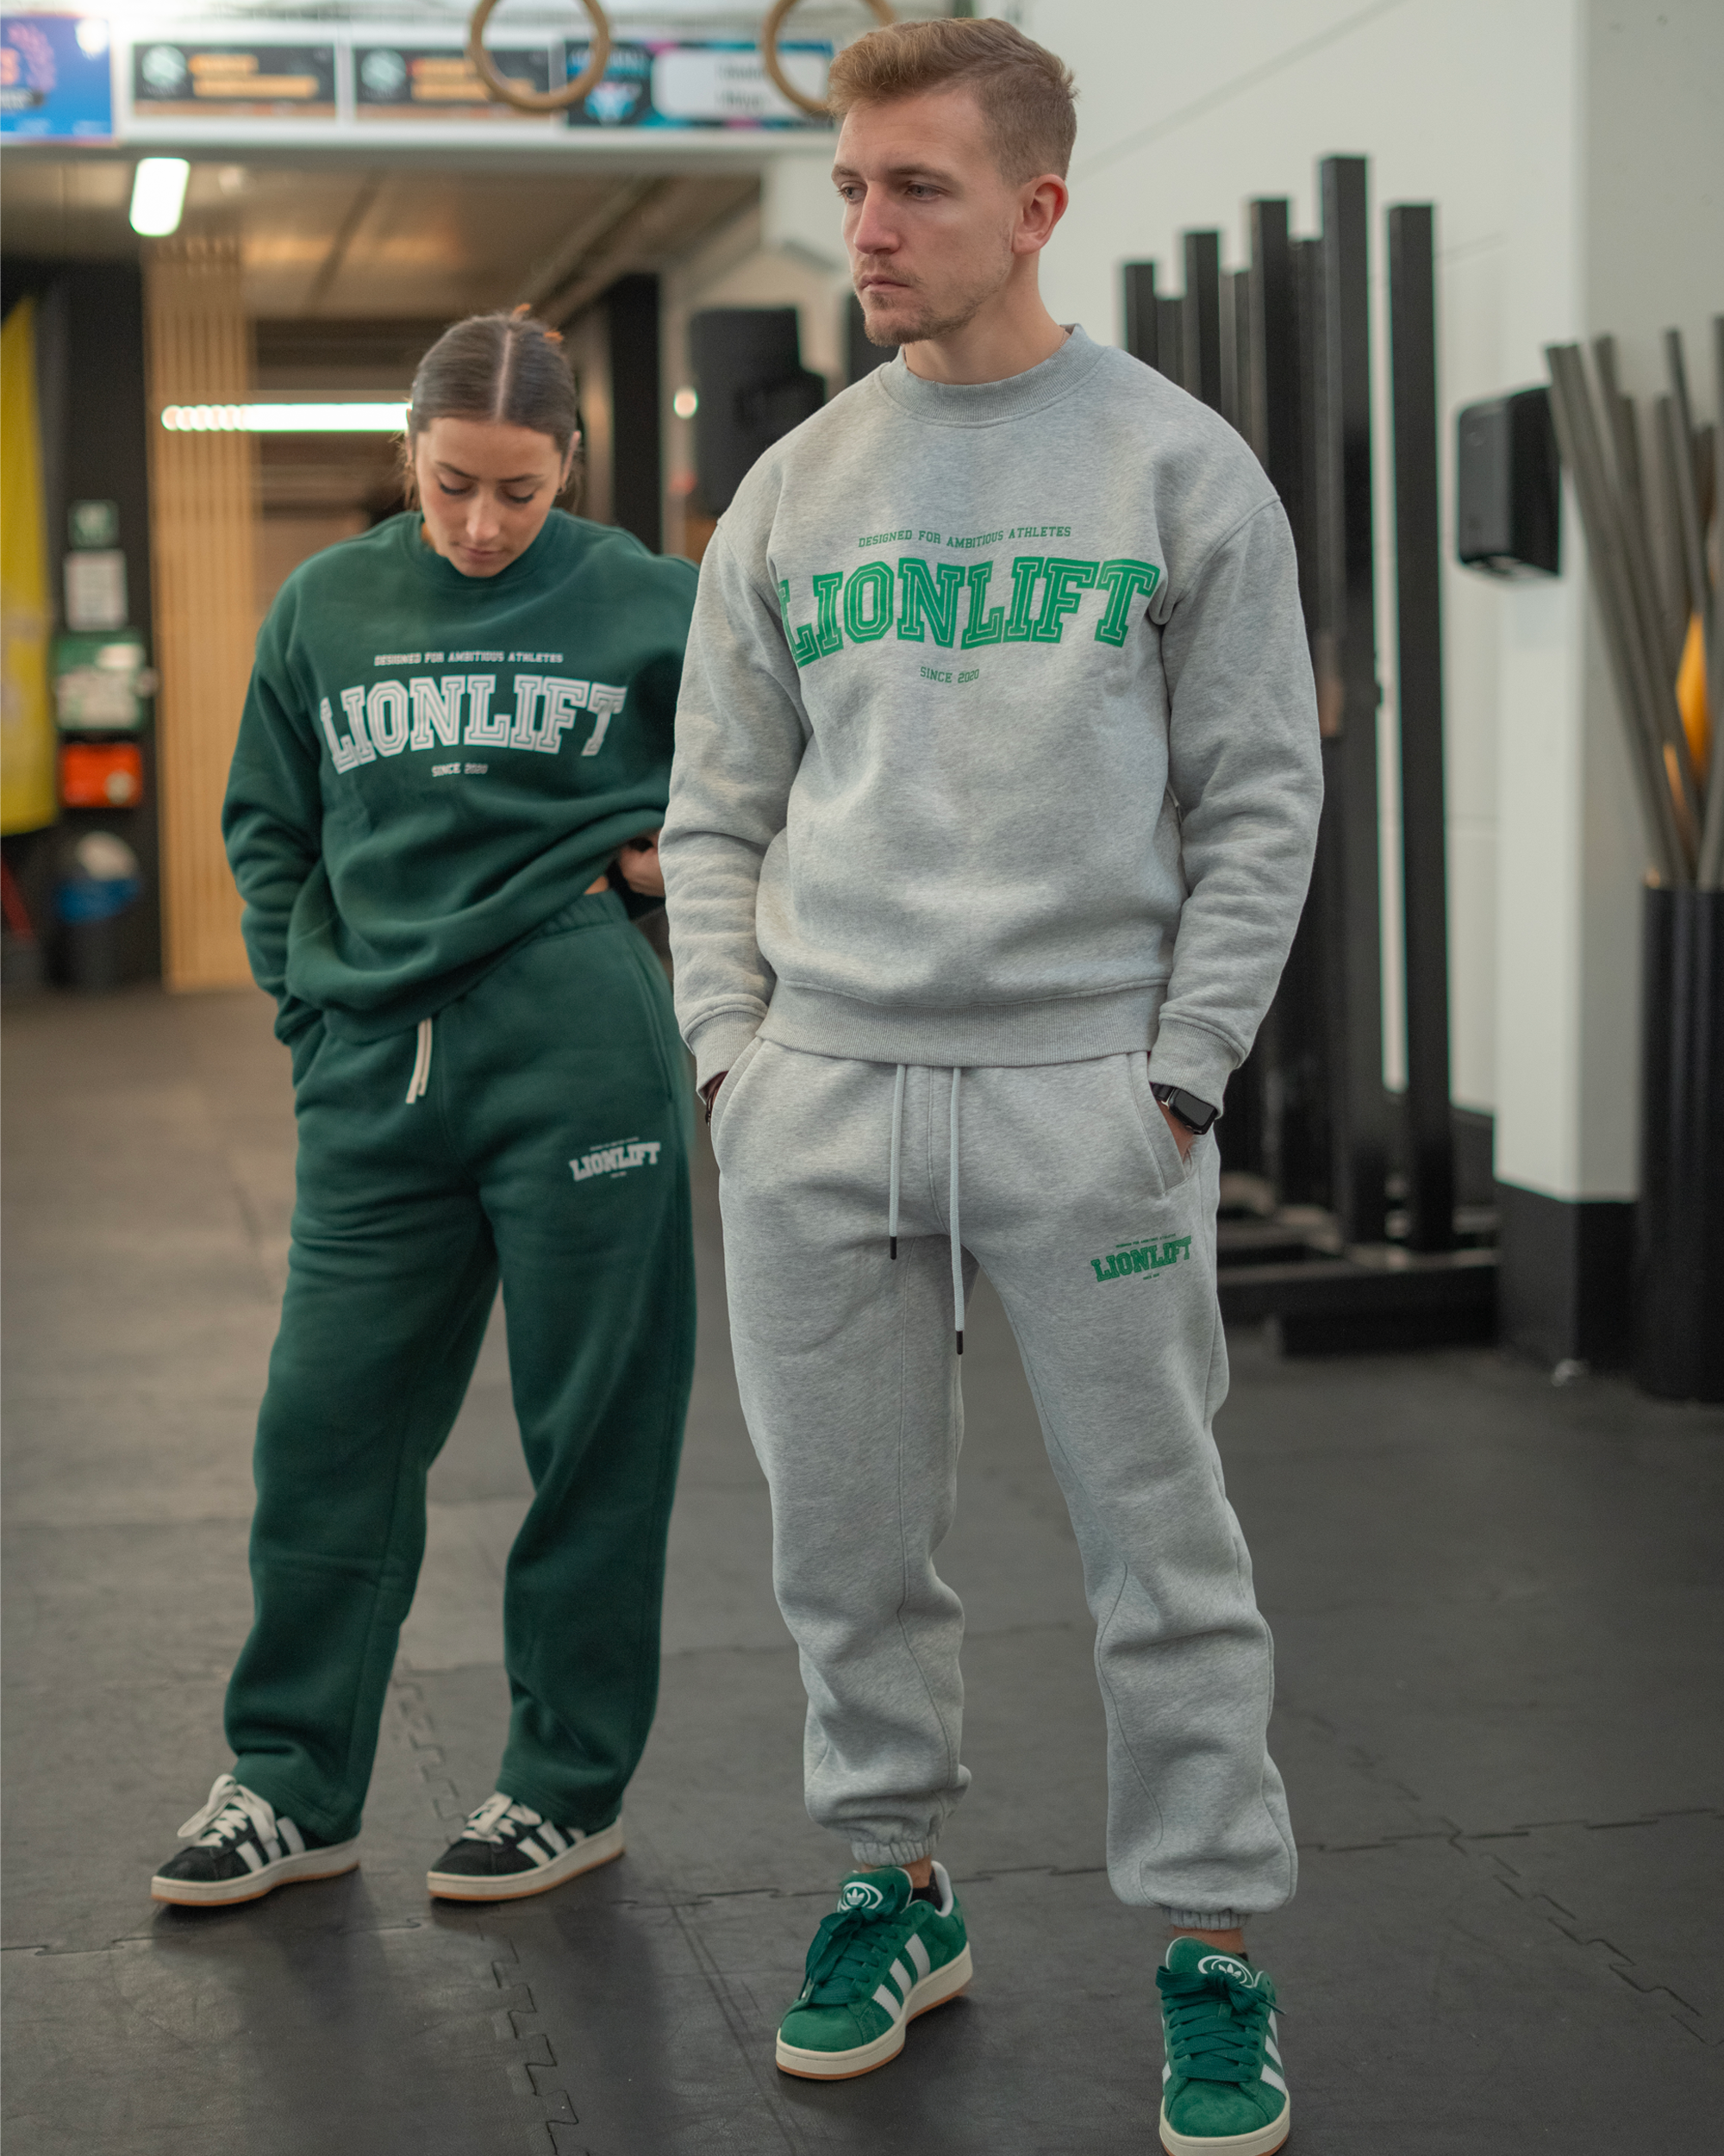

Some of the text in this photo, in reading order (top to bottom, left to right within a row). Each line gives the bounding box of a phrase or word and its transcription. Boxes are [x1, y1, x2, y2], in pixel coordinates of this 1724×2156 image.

[859, 526, 1071, 548] DESIGNED FOR AMBITIOUS ATHLETES
[778, 556, 1160, 669] LIONLIFT
[374, 650, 564, 666] DESIGNED FOR AMBITIOUS ATHLETES
[920, 666, 979, 684] SINCE 2020
[320, 673, 628, 774] LIONLIFT
[432, 762, 461, 777] SINCE
[569, 1140, 661, 1182] LIONLIFT
[1090, 1234, 1192, 1283] LIONLIFT
